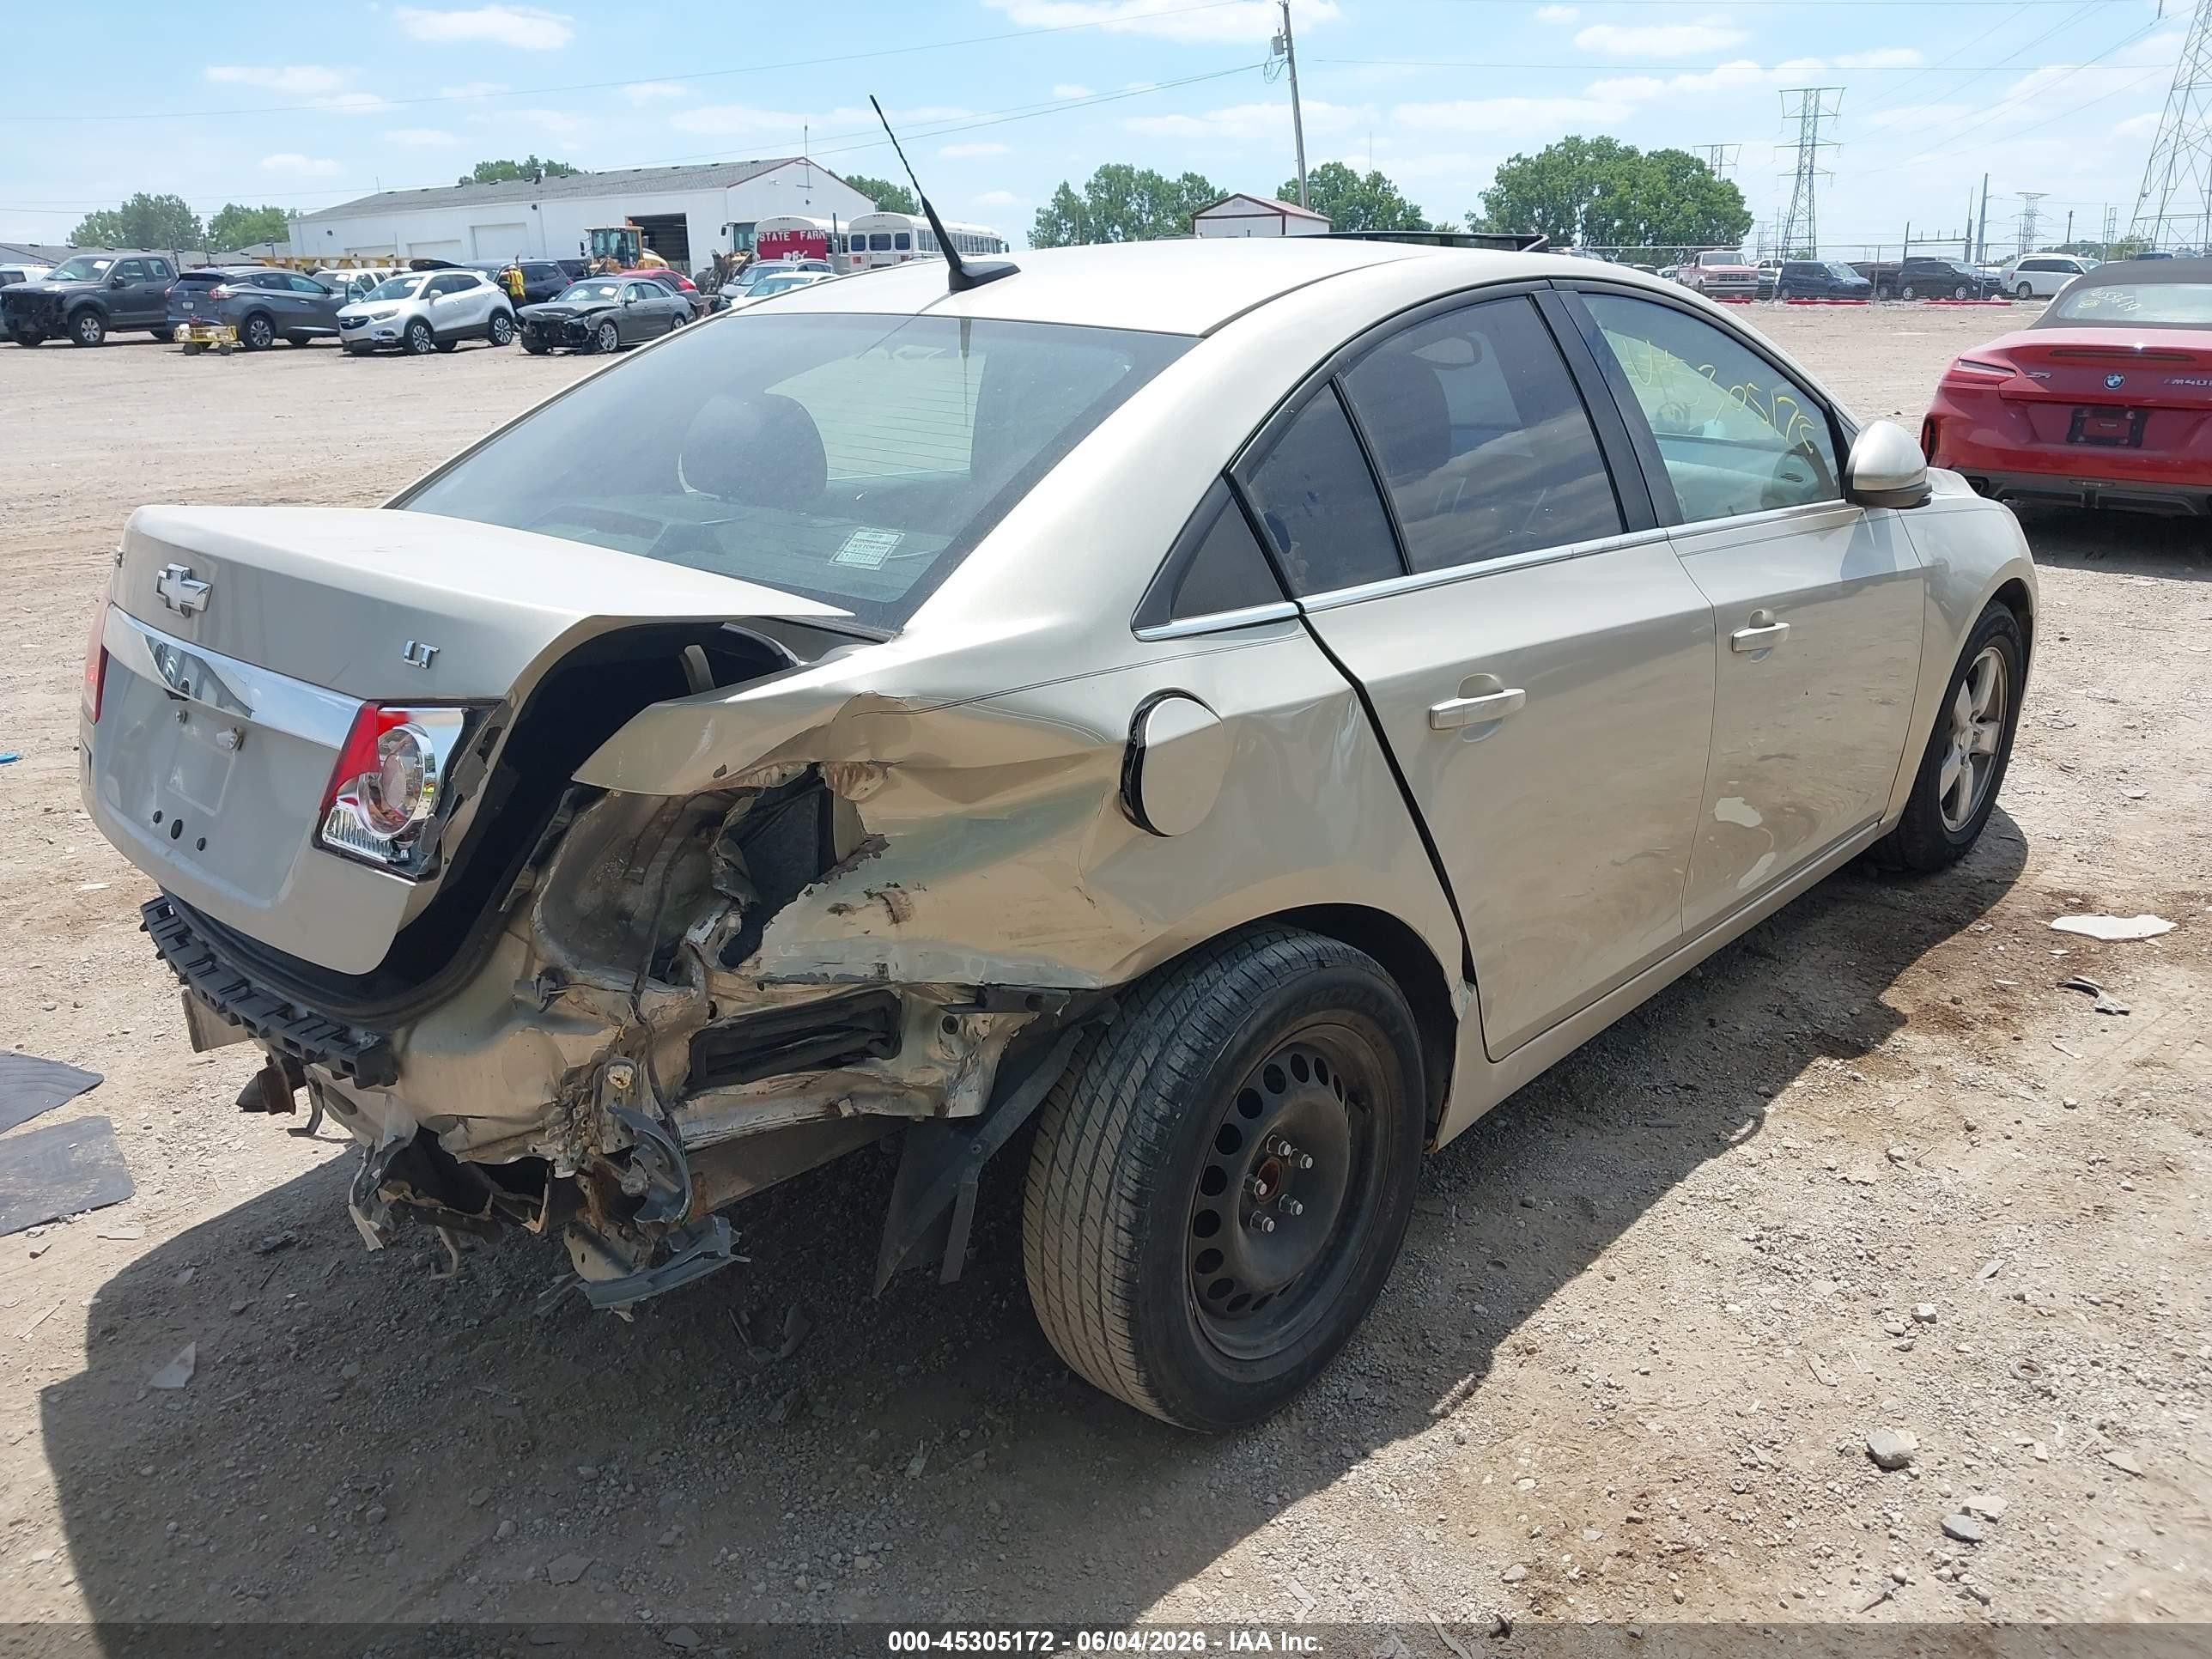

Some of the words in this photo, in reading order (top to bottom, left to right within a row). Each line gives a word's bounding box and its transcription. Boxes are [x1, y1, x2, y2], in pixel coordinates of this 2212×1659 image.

[759, 231, 790, 242] STATE
[799, 230, 826, 241] FARM
[402, 638, 440, 669] LT
